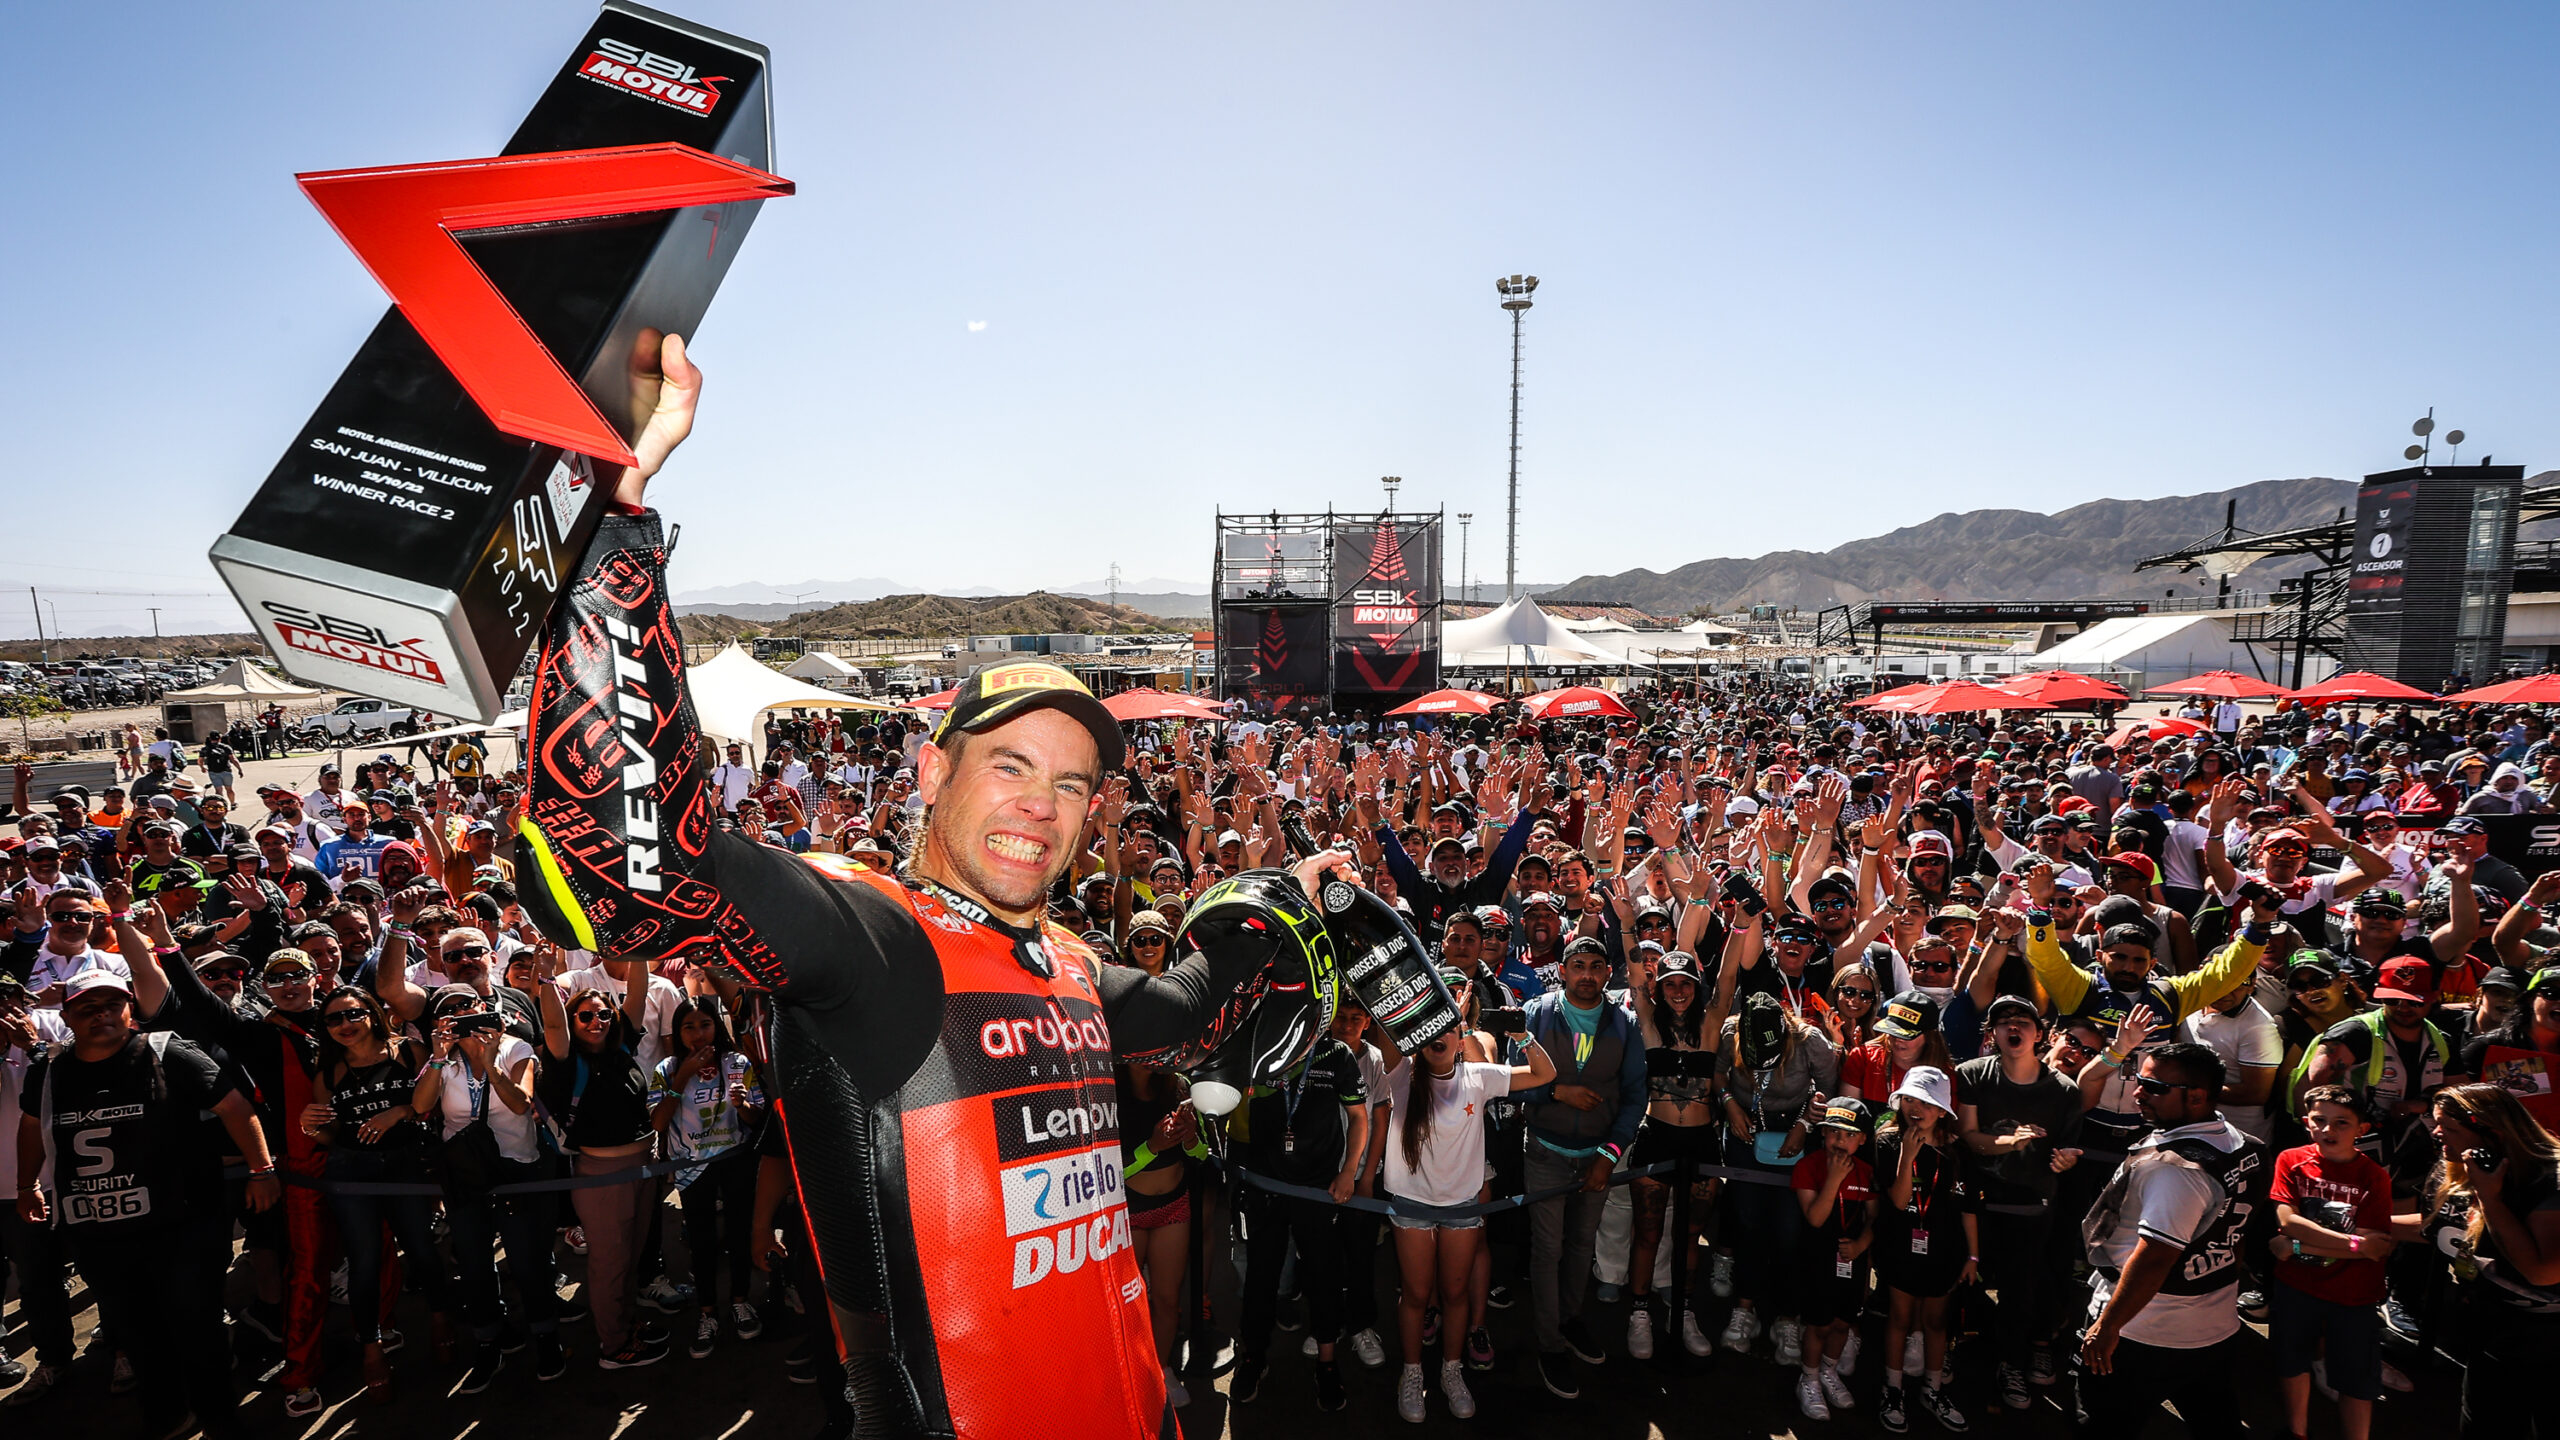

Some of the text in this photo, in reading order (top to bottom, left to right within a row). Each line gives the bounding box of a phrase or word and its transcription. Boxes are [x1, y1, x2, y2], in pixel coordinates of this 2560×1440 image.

[587, 59, 708, 111] MOTUL
[593, 38, 728, 94] SBK
[576, 71, 709, 119] FIM SUPERBIKE WORLD CHAMPIONSHIP
[310, 438, 351, 458] SAN
[350, 451, 401, 472] JUAN
[416, 466, 493, 496] VILLICUM
[337, 426, 487, 473] MOTUL ARGENTINEAN ROUND
[313, 473, 456, 520] WINNER RACE 2
[2356, 559, 2404, 573] ASCENSOR
[2377, 537, 2387, 555] 1
[1353, 589, 1419, 606] SBK
[1356, 607, 1417, 622] MOTUL
[261, 601, 433, 659] SBK
[291, 630, 437, 679] MOTUL
[1561, 699, 1601, 714] BRAHMA
[2398, 829, 2447, 845] MOTU
[1390, 935, 1408, 955] DOC
[1371, 972, 1432, 1019] PROSECCO DOC
[1411, 1006, 1456, 1047] PROSECCO
[101, 1105, 142, 1119] MOTUL
[352, 1099, 392, 1116] FOR
[1021, 1102, 1120, 1144] Lenov
[73, 1127, 115, 1177] S
[1062, 1153, 1116, 1207] riello
[1012, 1207, 1132, 1290] DUCA
